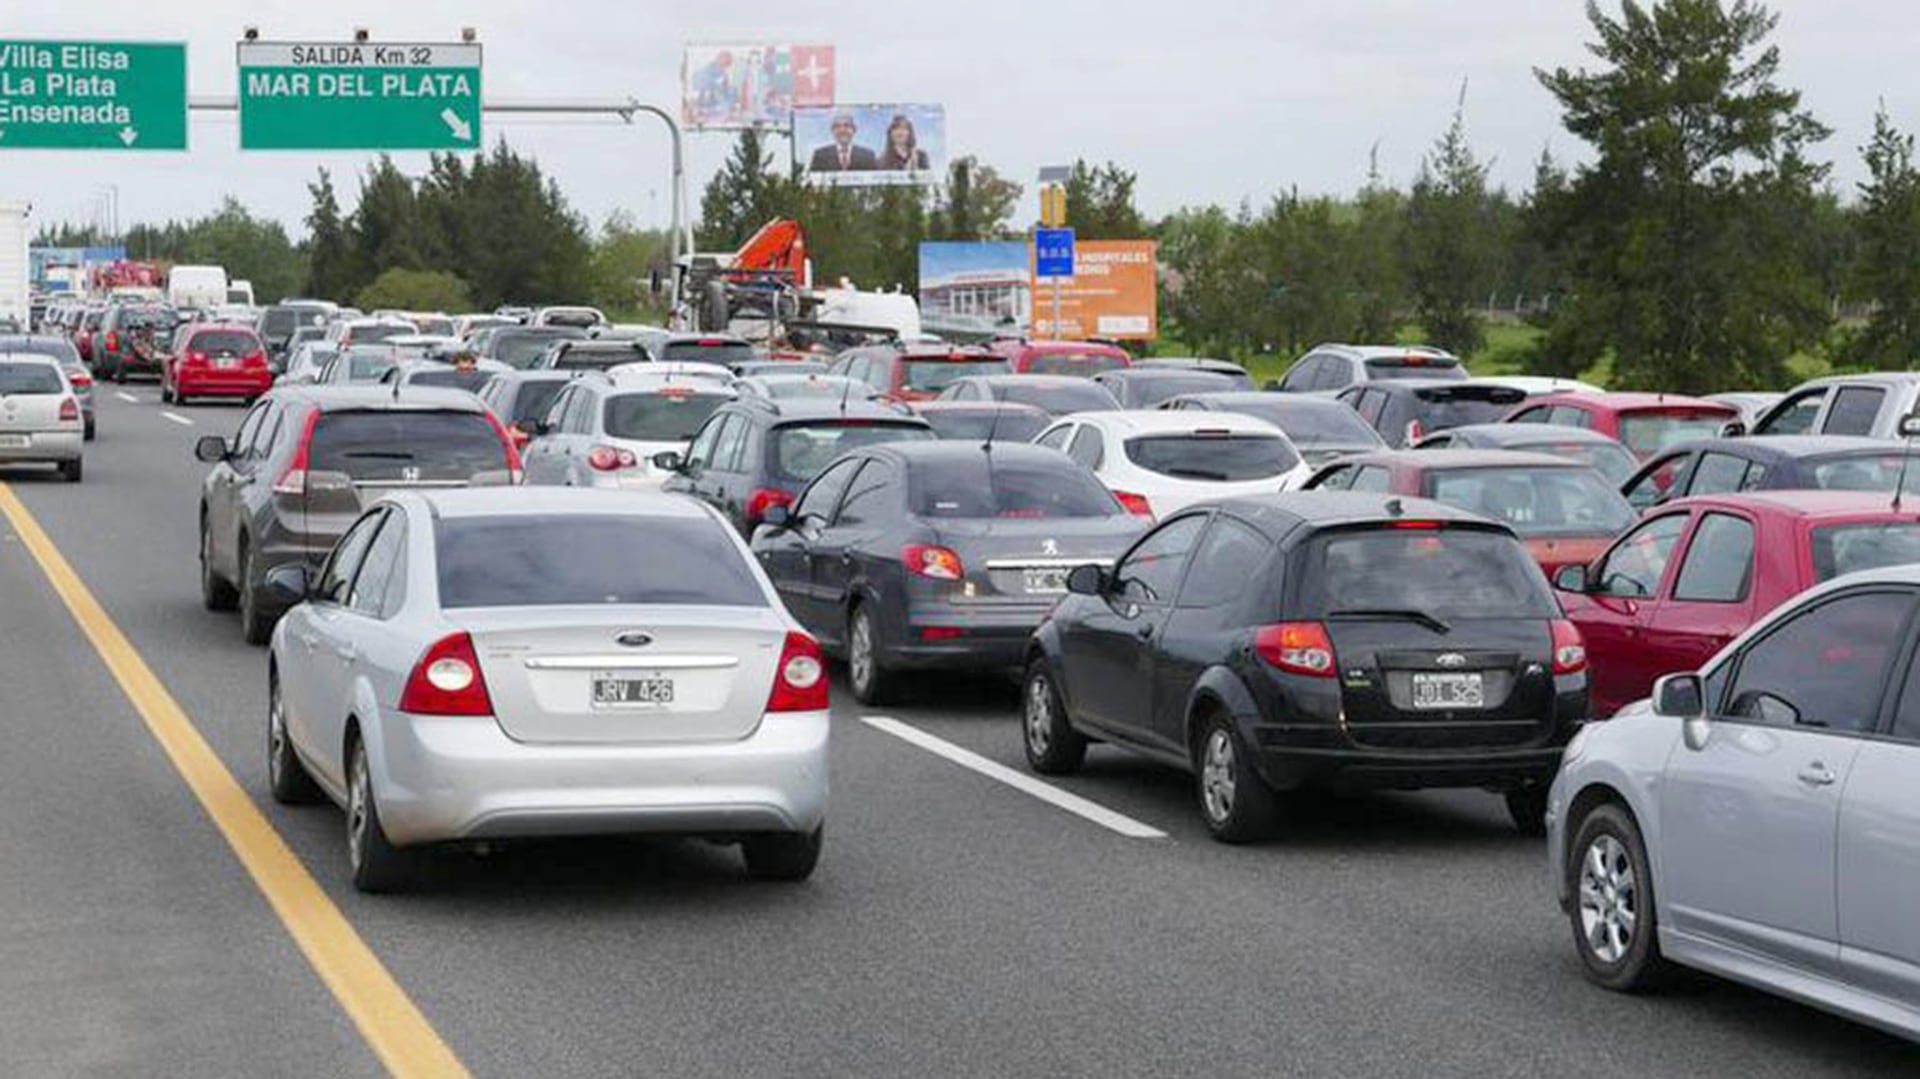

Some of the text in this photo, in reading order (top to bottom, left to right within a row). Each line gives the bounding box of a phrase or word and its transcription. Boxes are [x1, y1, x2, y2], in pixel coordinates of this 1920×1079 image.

[61, 45, 129, 69] Elisa
[291, 47, 432, 65] SALIDA Km 32
[2, 72, 117, 97] La Plata
[247, 73, 472, 97] MAR DEL PLATA
[640, 681, 672, 701] 426
